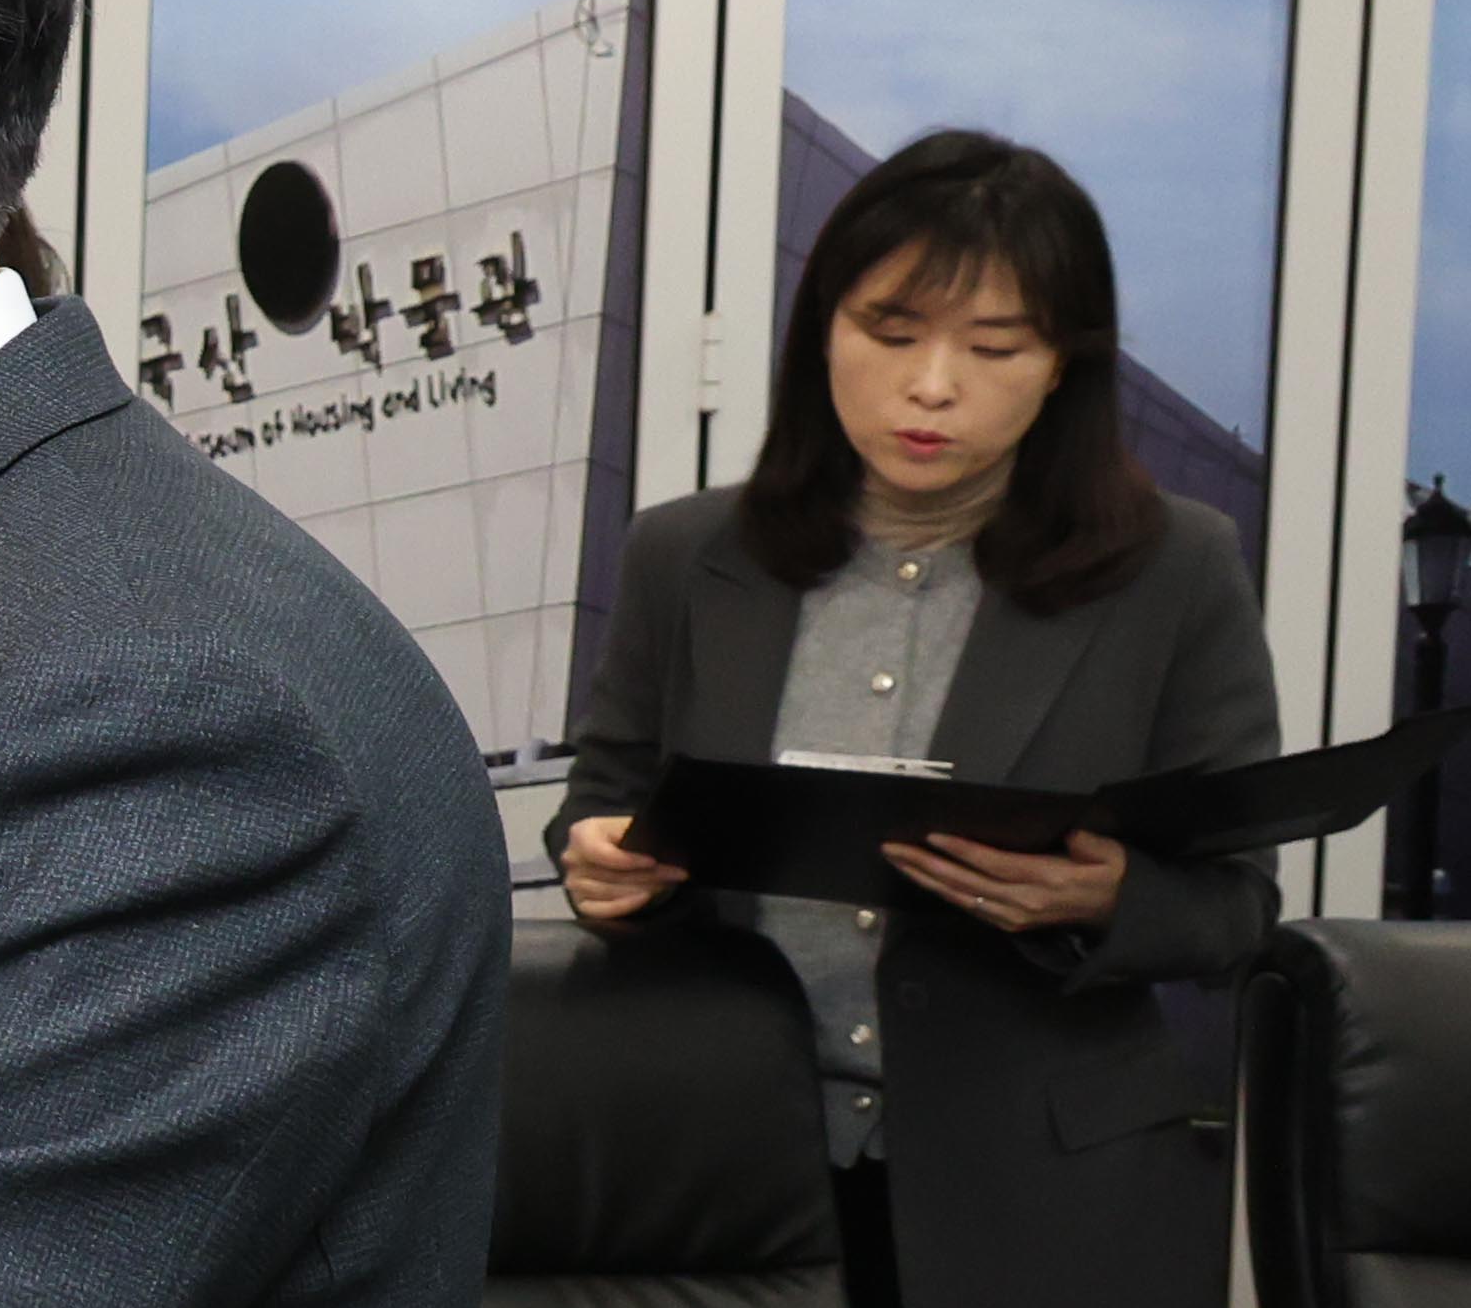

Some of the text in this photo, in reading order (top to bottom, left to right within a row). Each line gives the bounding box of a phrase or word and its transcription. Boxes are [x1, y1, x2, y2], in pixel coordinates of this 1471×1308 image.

[329, 229, 542, 377] 박물관
[187, 366, 498, 460] seum of Housing and Living
